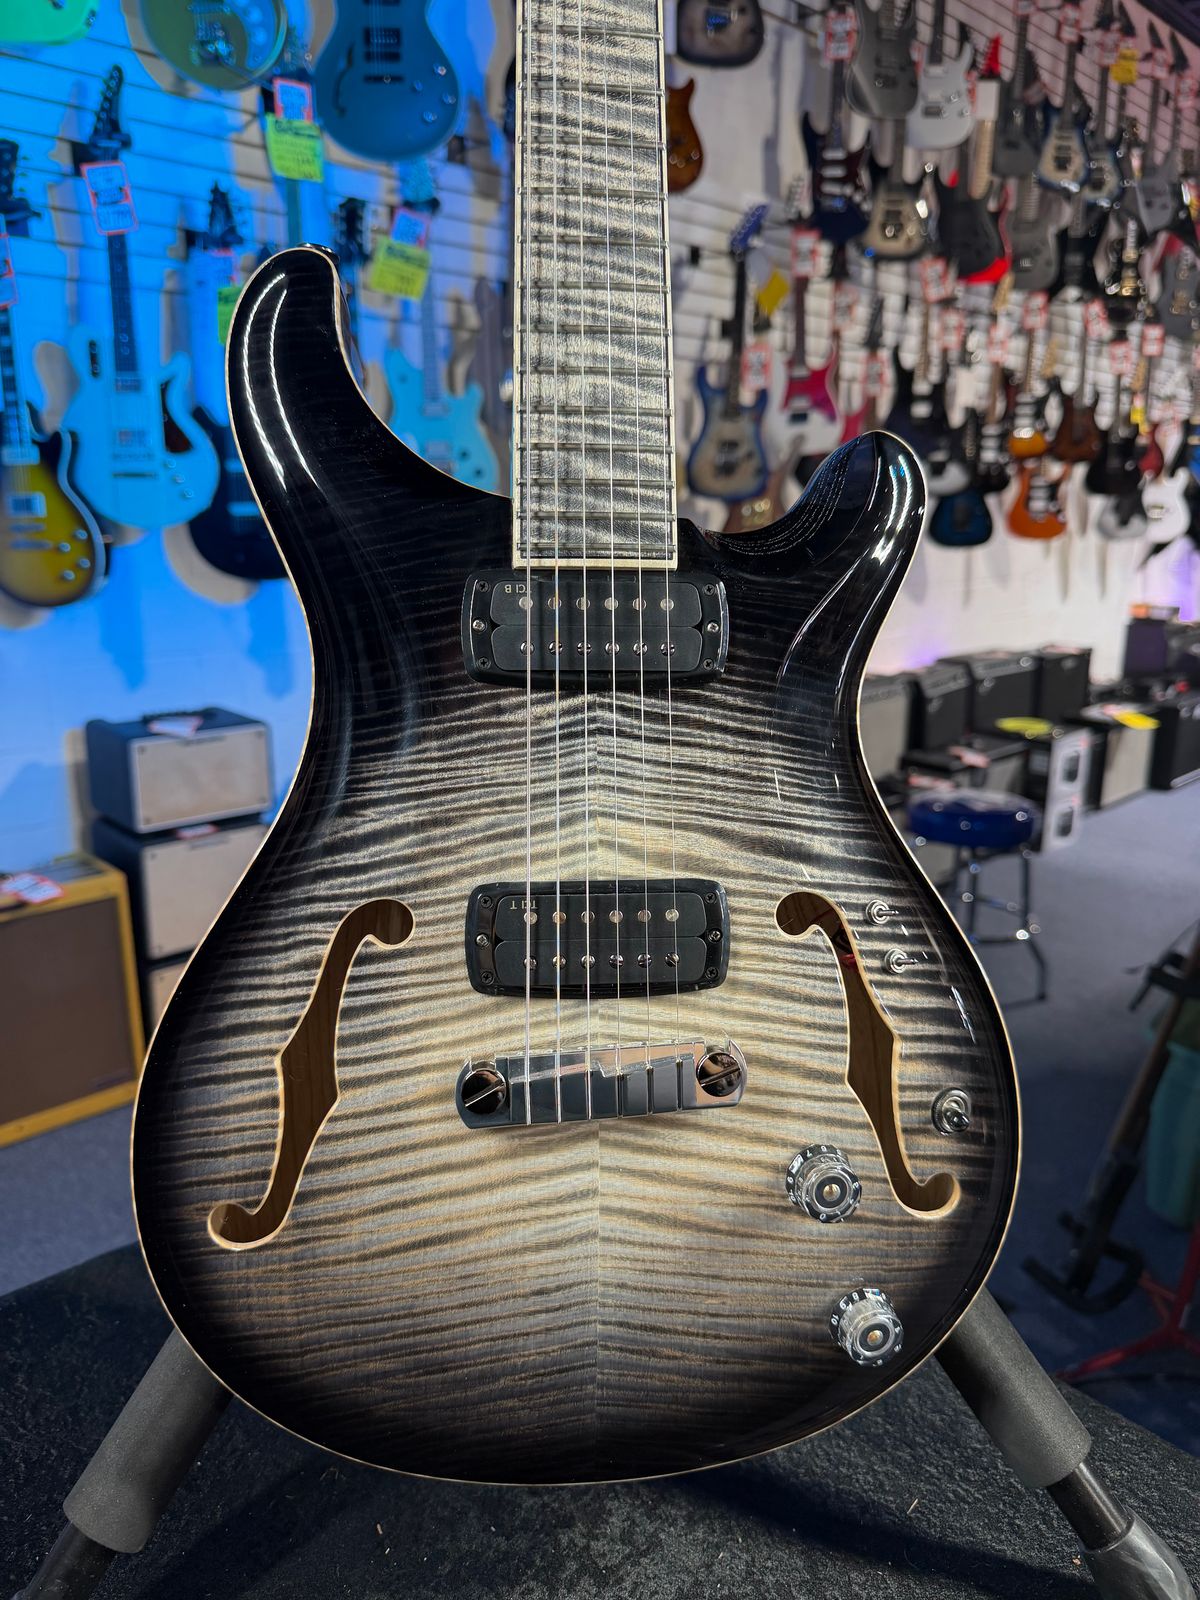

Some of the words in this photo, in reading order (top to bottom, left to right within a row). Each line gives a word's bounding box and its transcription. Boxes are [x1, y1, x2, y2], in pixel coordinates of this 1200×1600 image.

[505, 584, 511, 593] B
[510, 901, 517, 909] T
[852, 1292, 859, 1301] 8
[831, 1314, 839, 1325] 10
